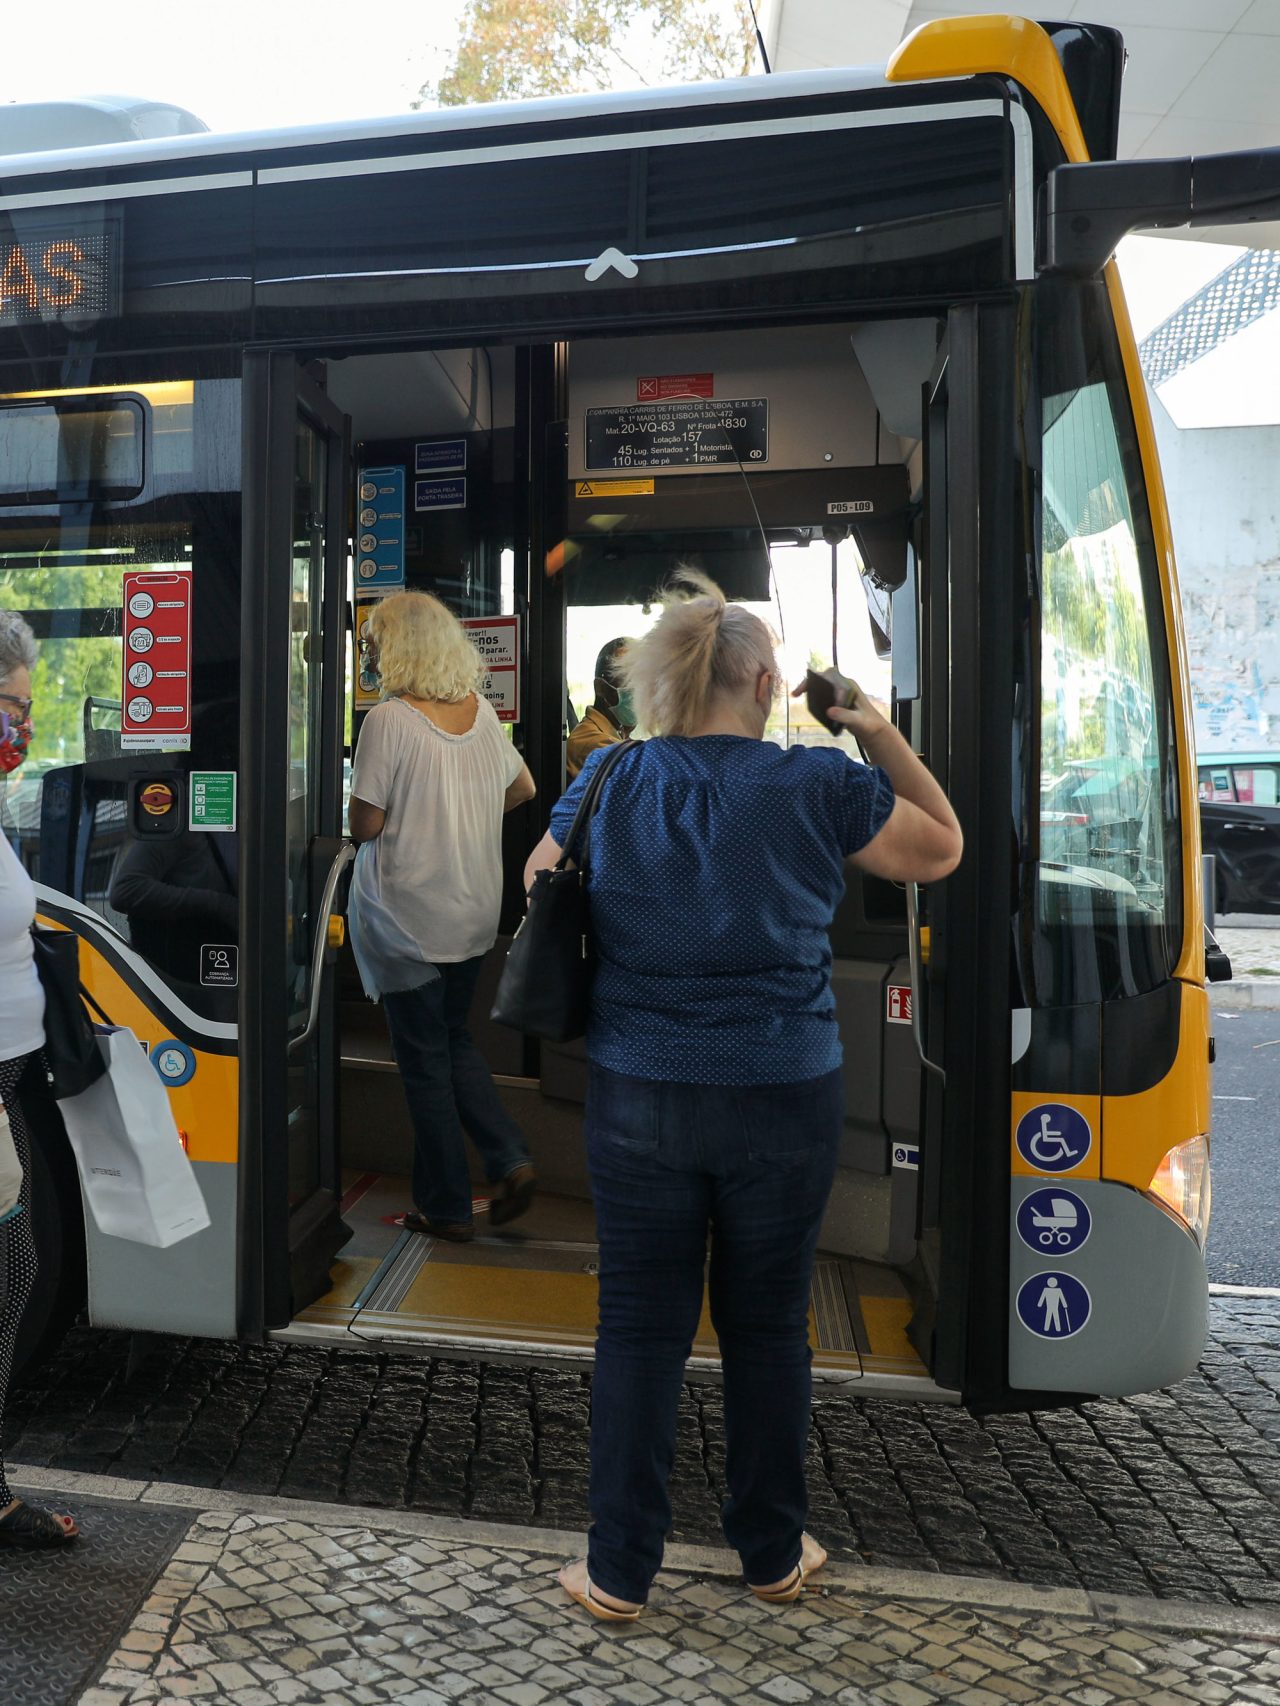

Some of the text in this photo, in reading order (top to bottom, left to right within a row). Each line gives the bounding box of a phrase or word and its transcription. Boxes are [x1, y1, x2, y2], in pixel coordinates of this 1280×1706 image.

[630, 405, 656, 414] CARRIS
[621, 421, 676, 434] 20-VQ-63
[653, 431, 702, 445] Lotação 157
[618, 445, 632, 455] 45
[650, 446, 684, 454] Sentados
[693, 442, 698, 452] 1
[700, 444, 733, 452] Motorista
[612, 456, 632, 466] 110
[693, 453, 698, 462] 1
[854, 502, 871, 512] L09
[486, 646, 508, 655] parar.
